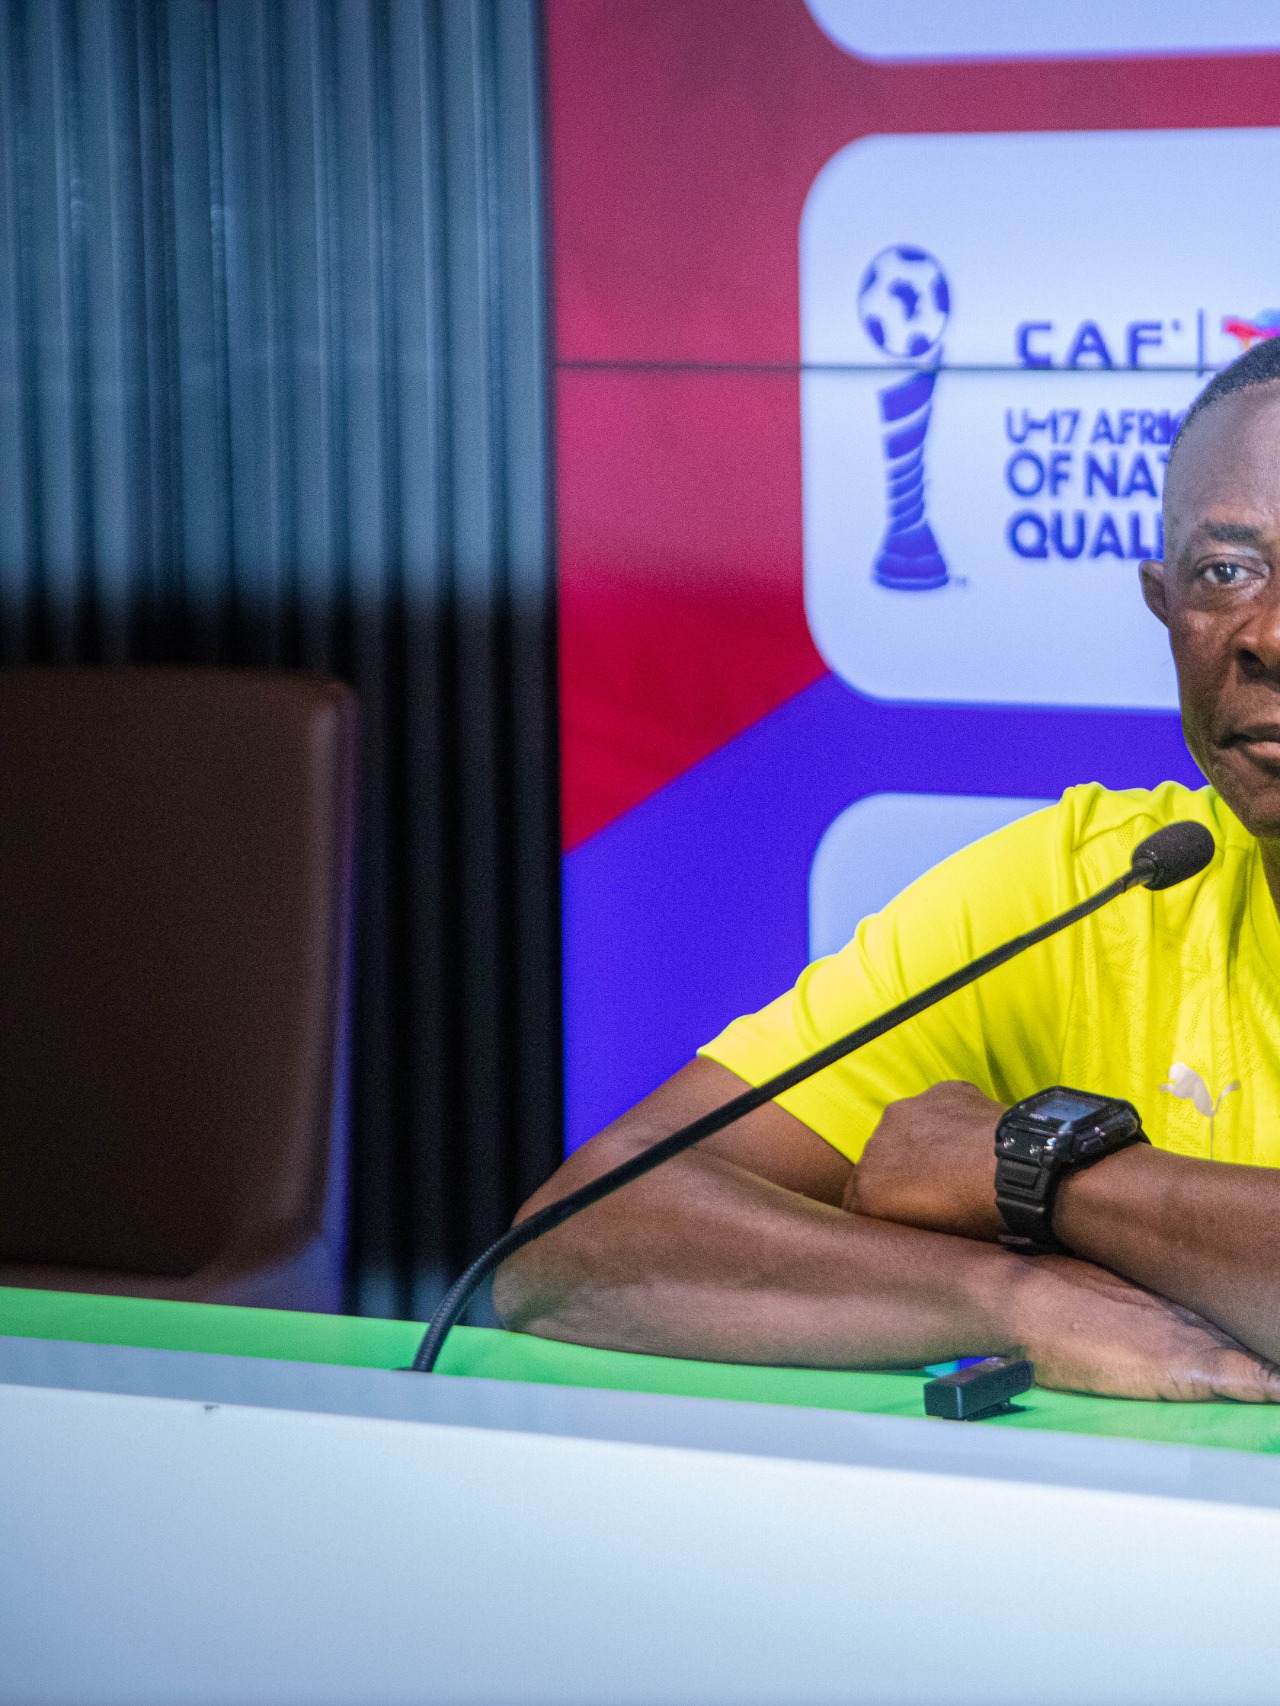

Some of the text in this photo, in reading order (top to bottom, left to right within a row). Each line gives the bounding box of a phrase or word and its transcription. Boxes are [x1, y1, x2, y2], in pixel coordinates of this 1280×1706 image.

[1006, 410, 1081, 444] U-17
[1006, 451, 1168, 497] OF NA
[1006, 510, 1164, 559] QUALI
